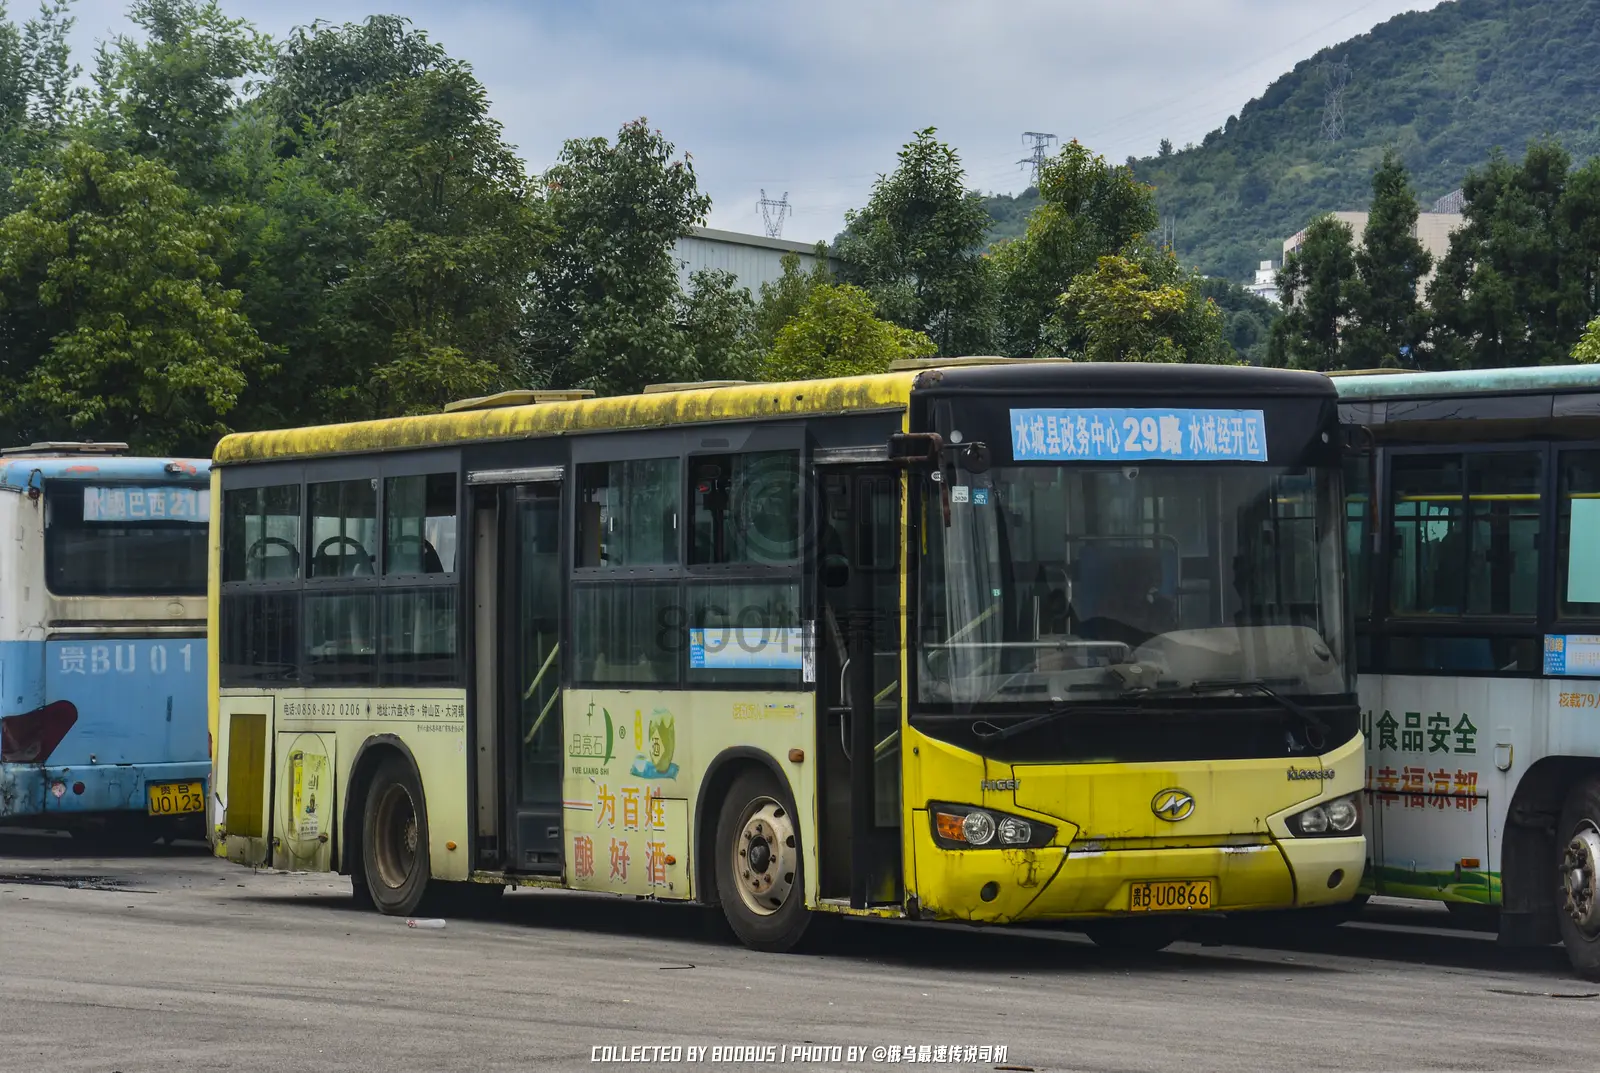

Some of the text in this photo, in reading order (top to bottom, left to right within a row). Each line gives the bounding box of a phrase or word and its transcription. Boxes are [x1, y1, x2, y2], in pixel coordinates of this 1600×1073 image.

[1015, 414, 1260, 455] 水城县政务中心 29路 水城经开区
[572, 767, 582, 775] YUE
[600, 768, 610, 776] SHI
[150, 794, 202, 815] U0123
[597, 784, 666, 832] 为百姓
[574, 835, 667, 888] 酿好酒
